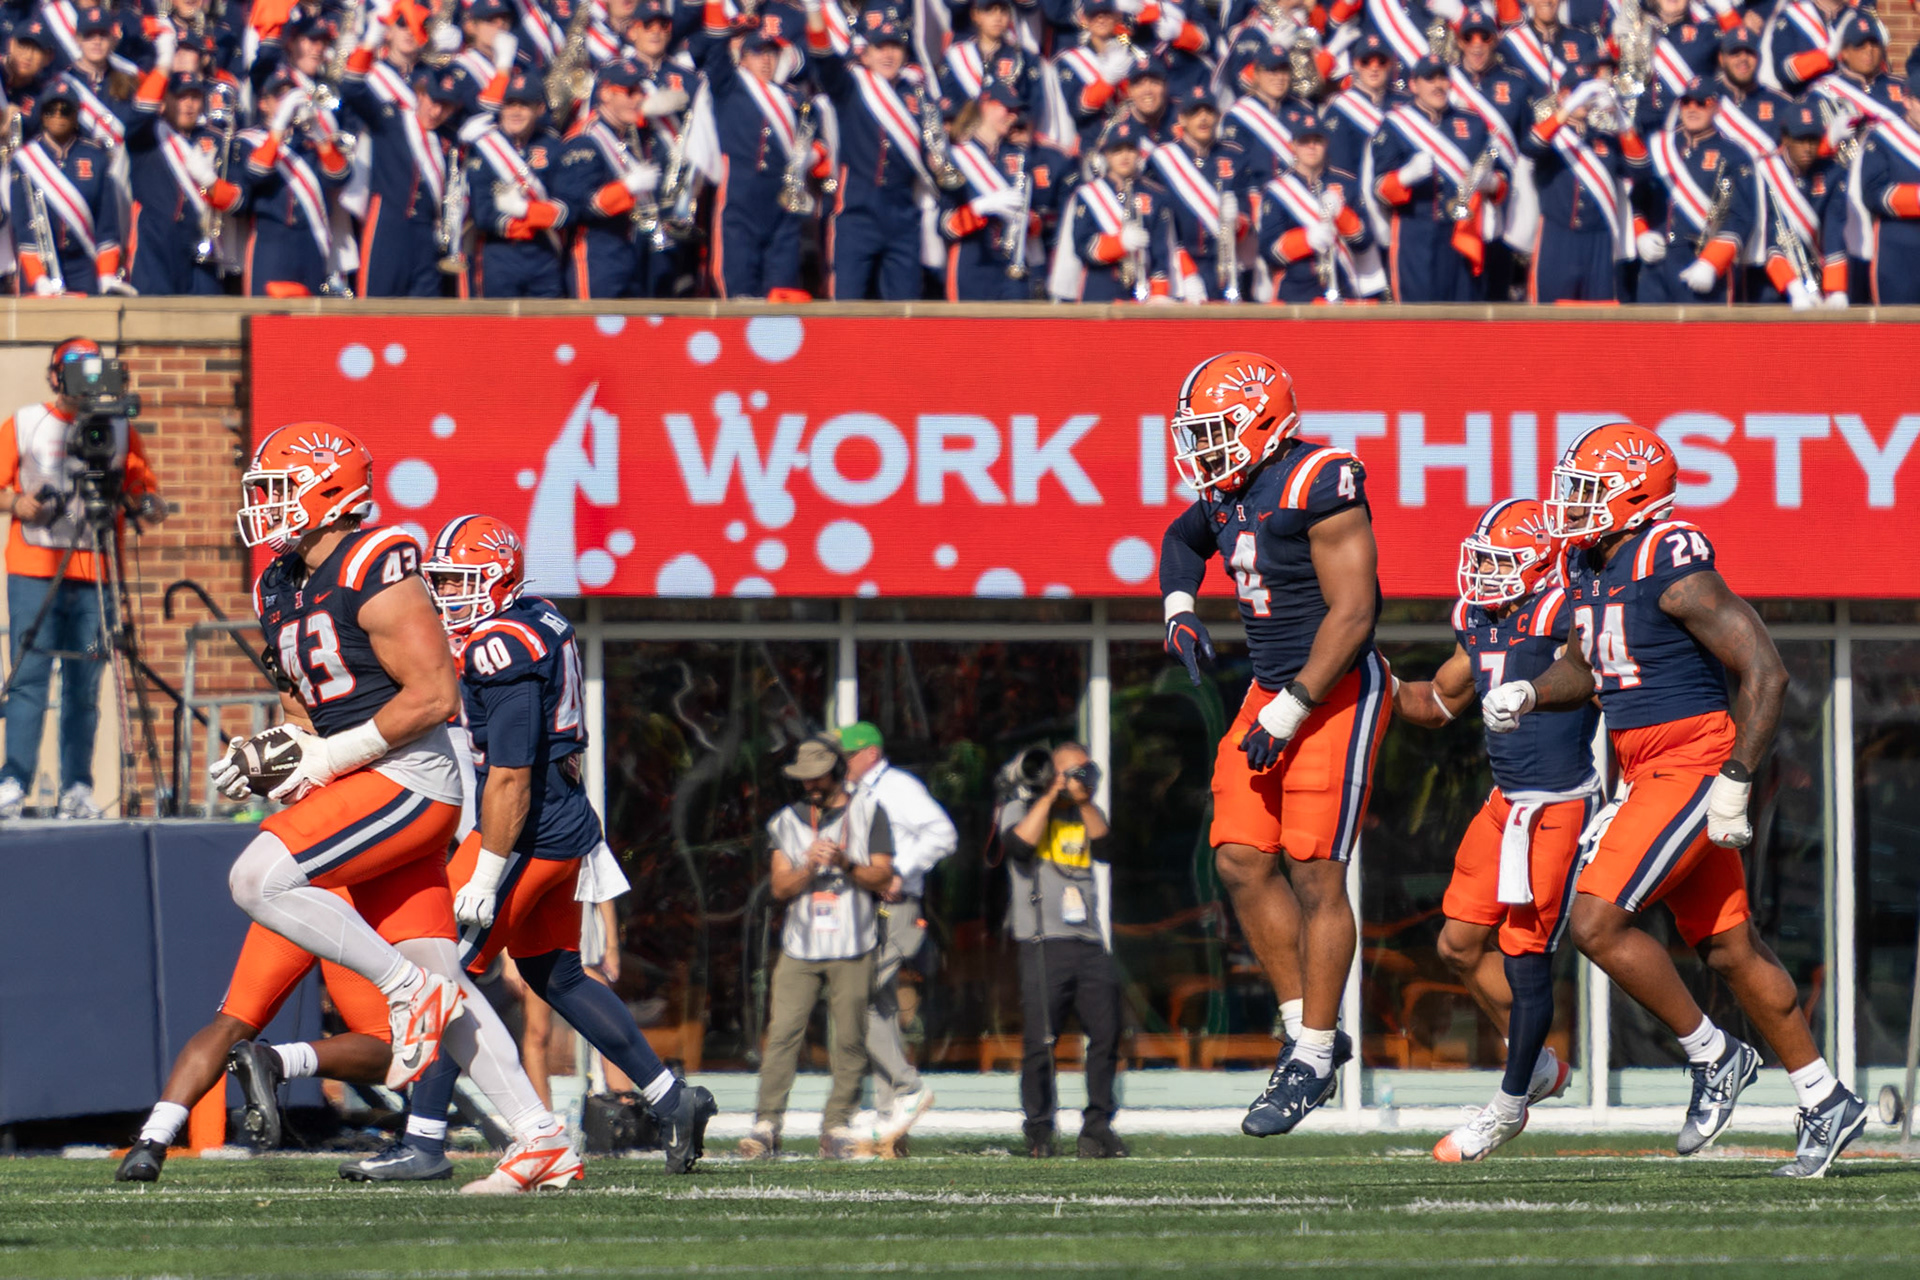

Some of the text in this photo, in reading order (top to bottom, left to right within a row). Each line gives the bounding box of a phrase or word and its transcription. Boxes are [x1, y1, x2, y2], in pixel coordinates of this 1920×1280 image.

[1218, 364, 1277, 391] ILLINI
[289, 432, 352, 456] ILLINI
[663, 411, 1104, 506] WORK
[1607, 438, 1663, 465] ILLINI
[1338, 466, 1356, 500] 4
[382, 547, 417, 584] 43
[1666, 530, 1710, 568] 24
[1230, 531, 1271, 617] 4
[1517, 613, 1529, 633] C
[278, 610, 356, 707] 43
[474, 636, 512, 677] 40
[1479, 650, 1507, 690] 7
[554, 634, 588, 741] 4
